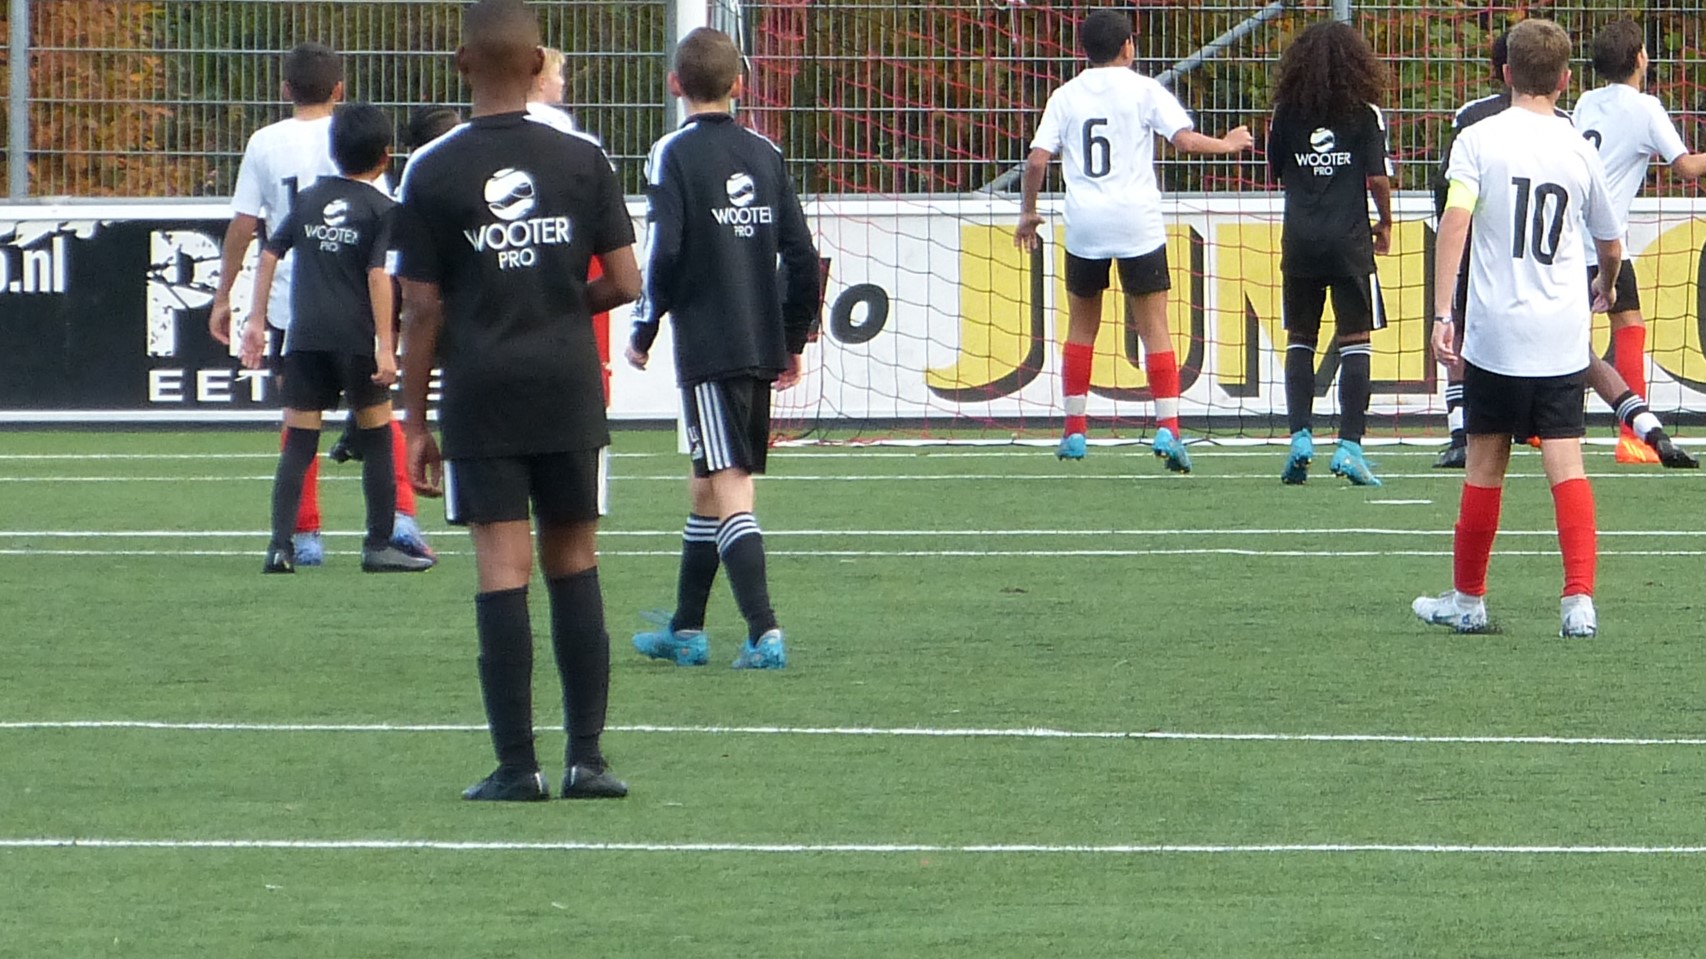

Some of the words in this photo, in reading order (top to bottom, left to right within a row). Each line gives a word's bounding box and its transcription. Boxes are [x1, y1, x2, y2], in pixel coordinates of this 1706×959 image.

[1083, 118, 1112, 178] 6
[1294, 152, 1351, 166] WOOTER
[1313, 166, 1333, 176] PRO
[463, 216, 571, 252] WOOTER
[1511, 176, 1569, 266] 10
[0, 236, 65, 292] .nl
[498, 248, 535, 269] PRO
